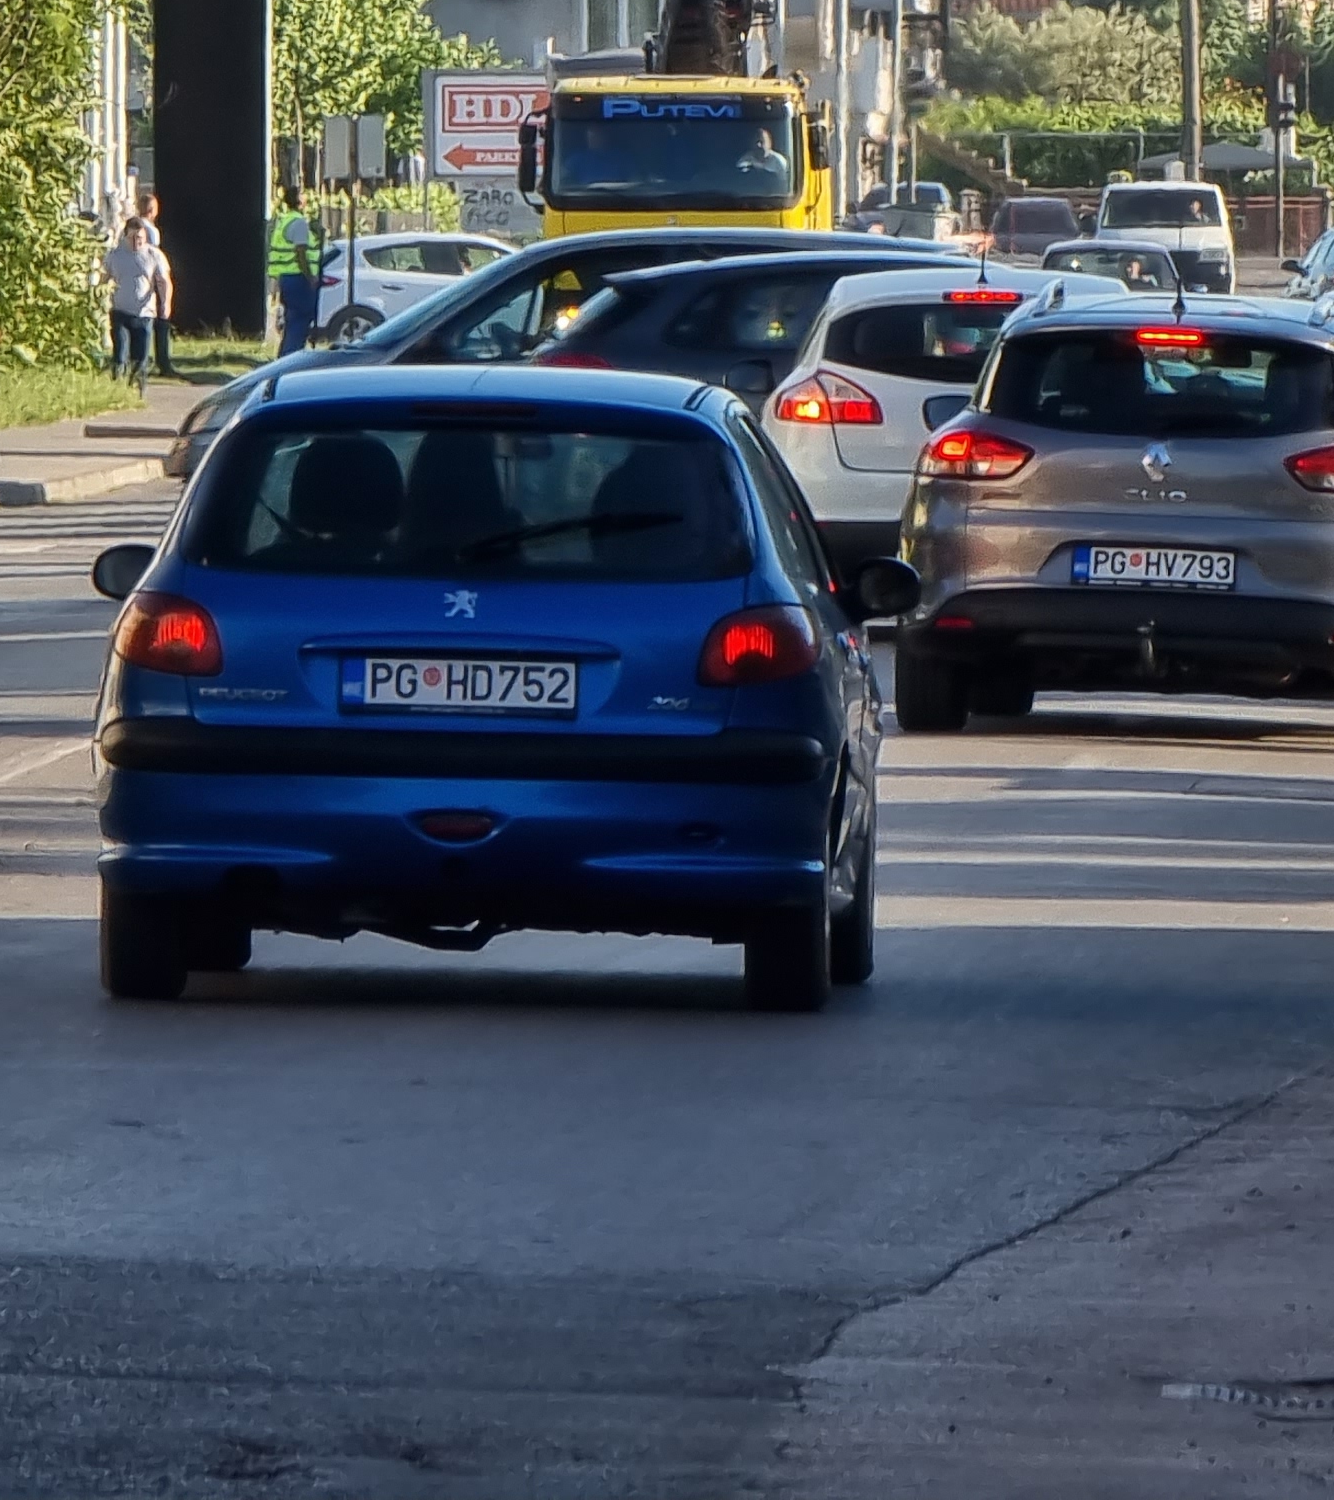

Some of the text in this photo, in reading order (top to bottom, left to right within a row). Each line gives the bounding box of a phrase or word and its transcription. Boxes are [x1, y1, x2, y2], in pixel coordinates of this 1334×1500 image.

[1093, 550, 1232, 581] PG HV793
[371, 662, 570, 704] PG HD752
